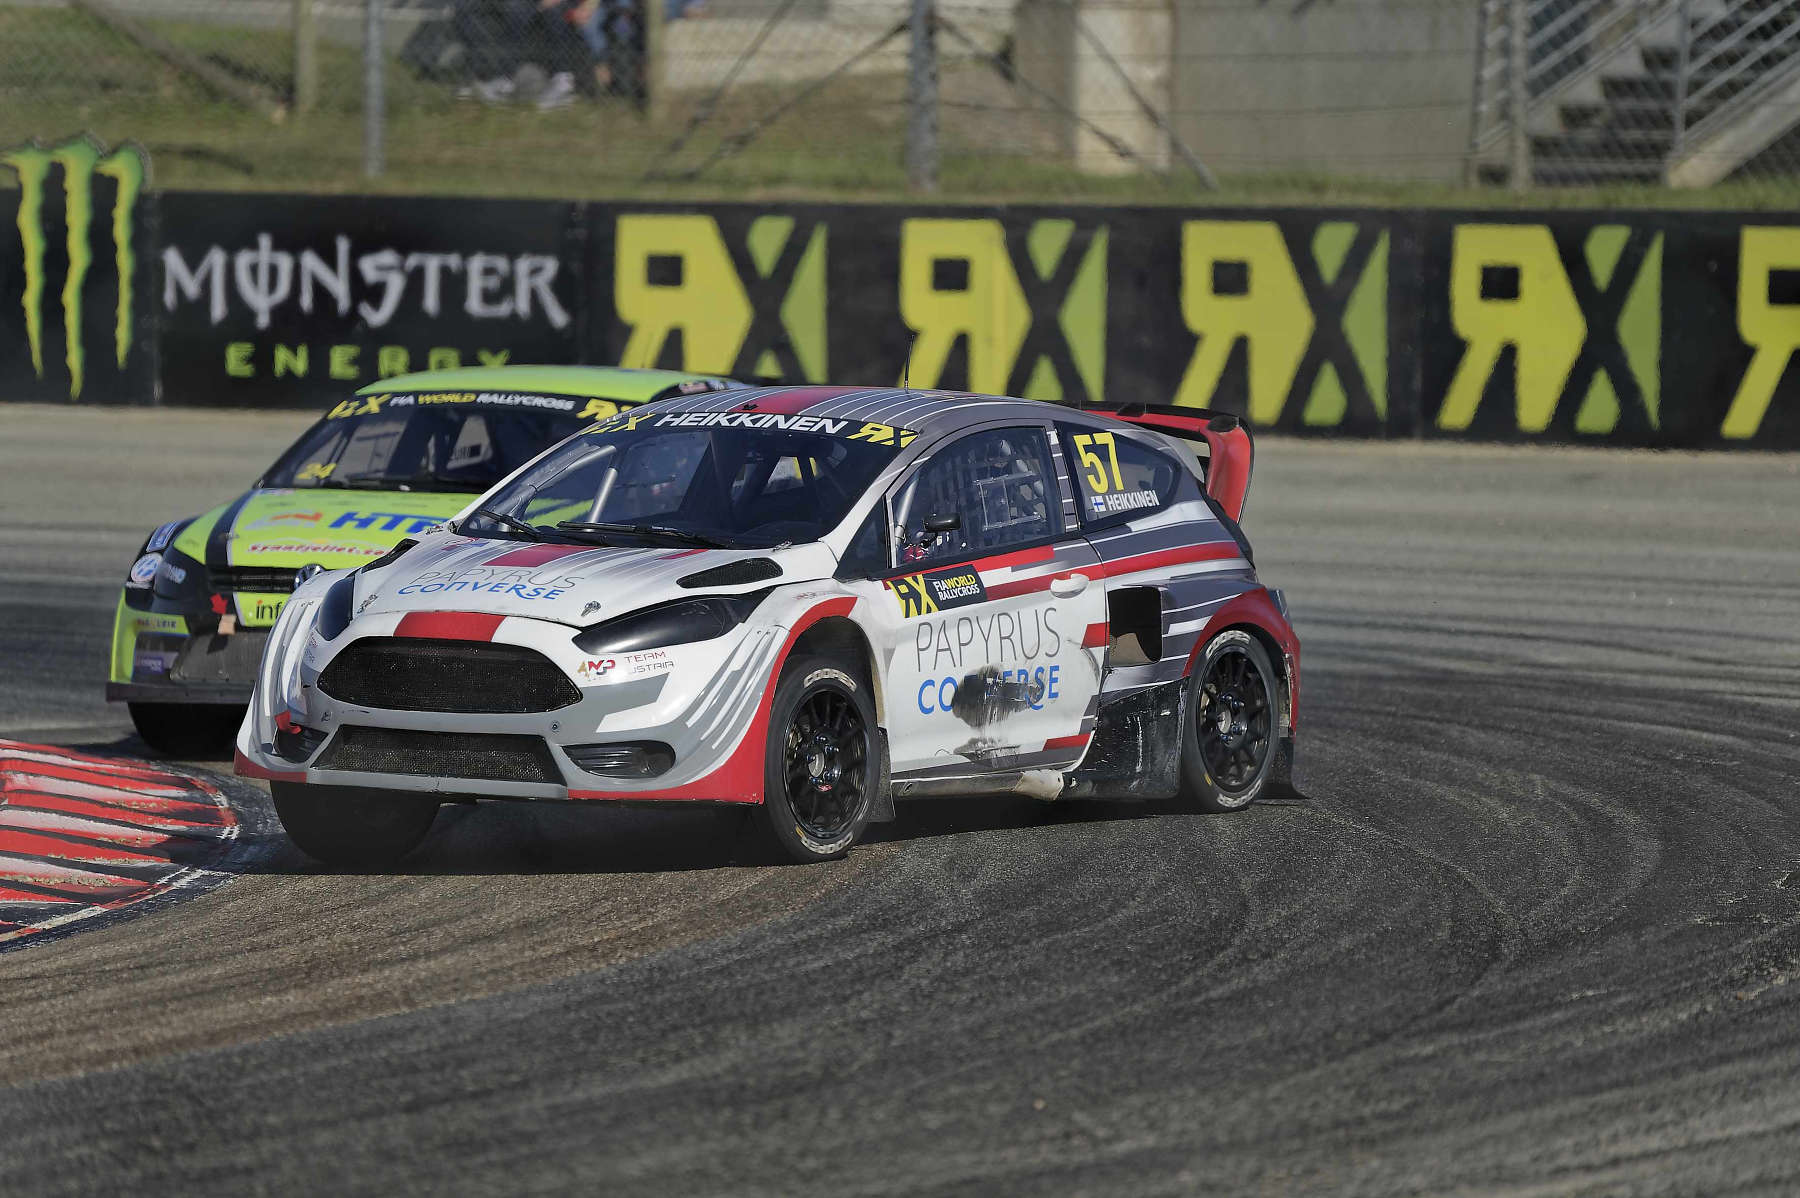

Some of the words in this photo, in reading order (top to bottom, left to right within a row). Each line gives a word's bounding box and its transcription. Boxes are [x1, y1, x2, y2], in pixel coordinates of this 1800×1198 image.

[160, 231, 571, 330] MONSTER
[418, 393, 477, 405] WORLD
[477, 393, 576, 411] RALLYCROSS
[654, 412, 849, 435] HEIKKINEN
[1073, 431, 1125, 494] 57
[1105, 490, 1160, 511] HEIKKINEN
[408, 568, 585, 589] PAPYRUS
[397, 581, 566, 600] CONVERSE
[938, 583, 981, 601] RALLYCROSS
[915, 607, 1060, 672] PAPYRUS
[624, 651, 666, 664] TEAM
[916, 665, 1060, 715] COERSE
